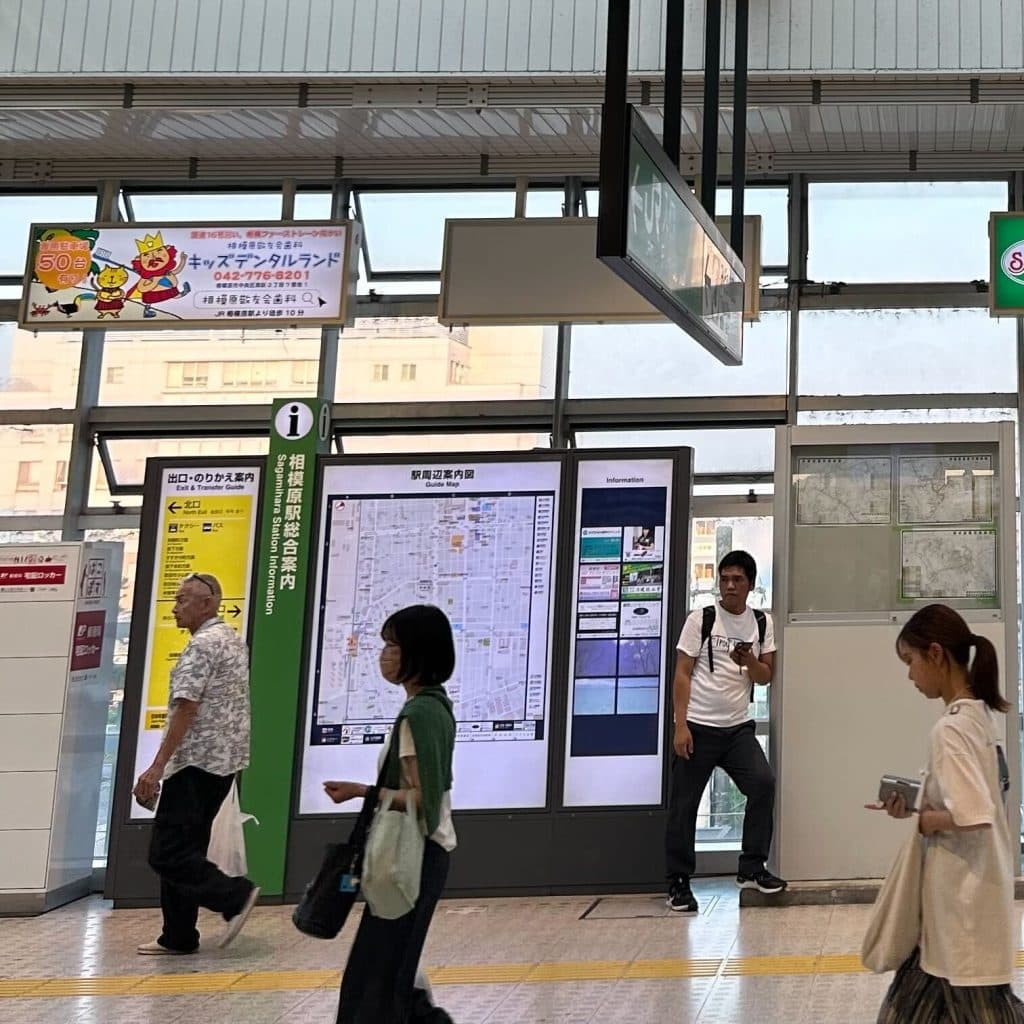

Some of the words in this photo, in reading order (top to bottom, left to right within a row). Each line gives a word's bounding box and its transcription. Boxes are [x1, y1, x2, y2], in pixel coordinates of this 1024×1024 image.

[39, 254, 88, 272] 50台
[188, 252, 341, 270] キッズデンタルランド
[167, 472, 255, 484] 出口・のりかえ案内
[411, 469, 475, 480] 駅周辺案内図
[273, 453, 287, 515] Sagamihara
[183, 500, 201, 509] 北口
[279, 453, 305, 590] 相模原駅総合案内
[270, 516, 283, 553] Station
[264, 556, 279, 616] Information
